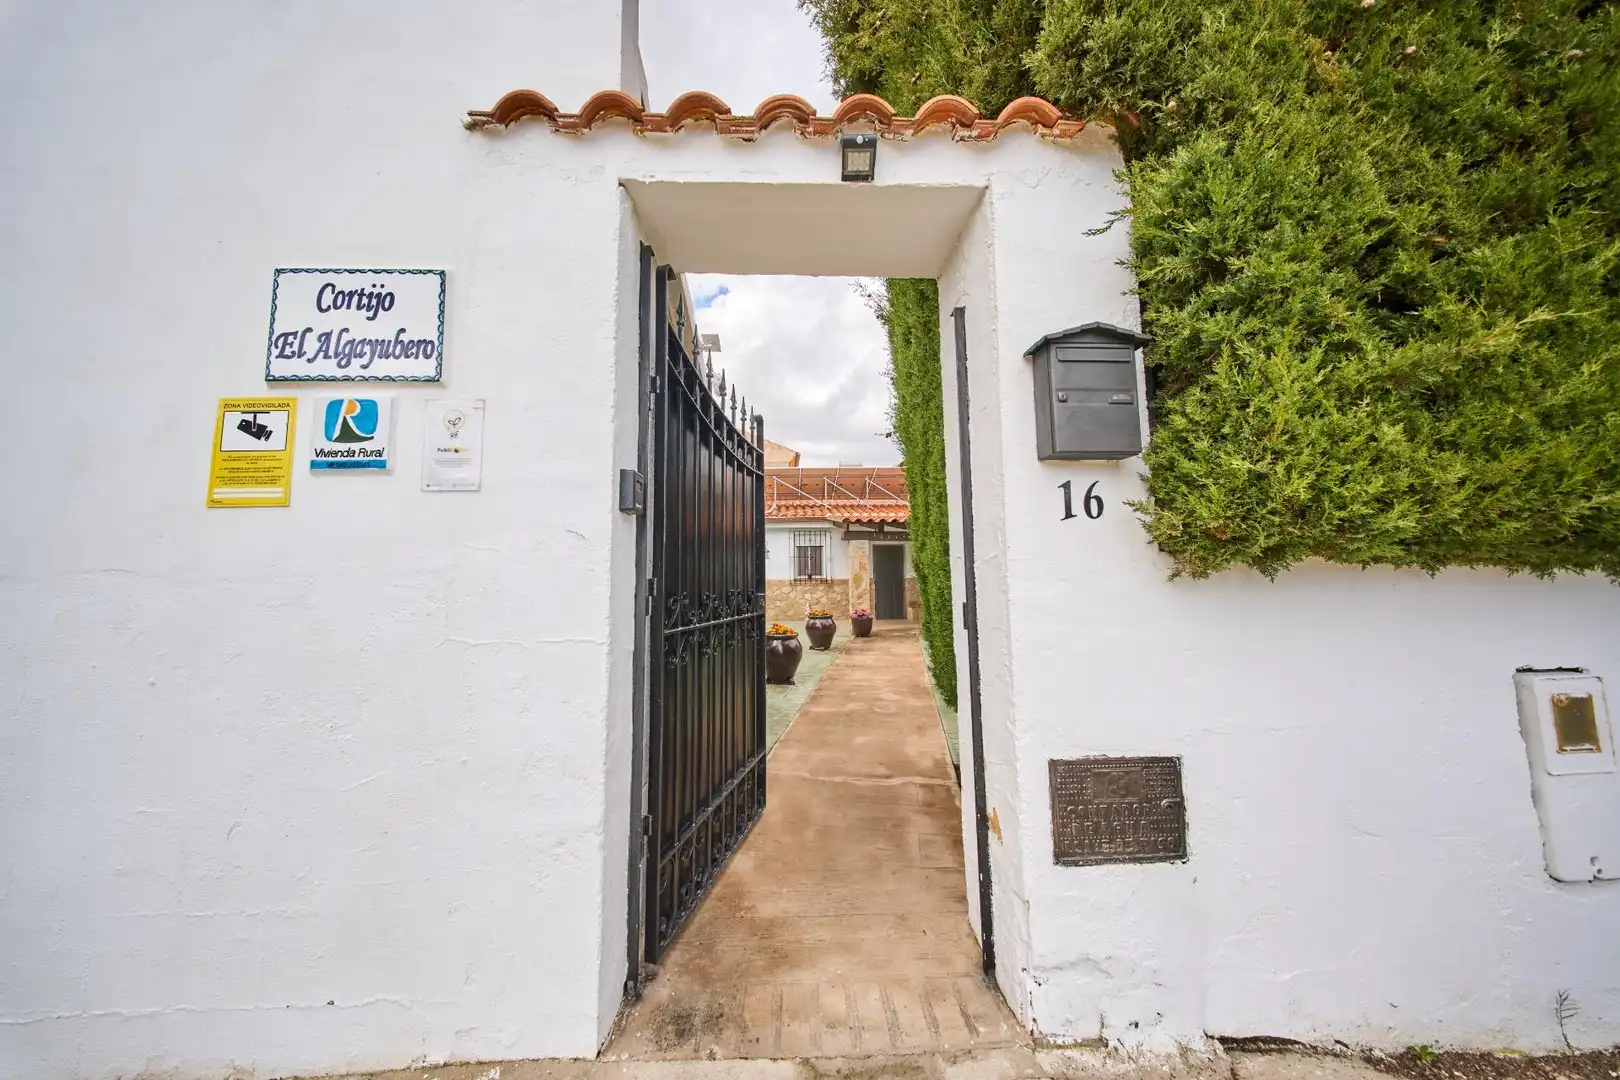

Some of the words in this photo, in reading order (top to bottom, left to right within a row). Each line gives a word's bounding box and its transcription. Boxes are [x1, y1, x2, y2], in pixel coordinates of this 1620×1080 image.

[316, 282, 396, 321] Cortijo
[274, 327, 314, 359] El
[306, 327, 436, 369] Algayubero
[314, 447, 356, 458] Vivienda
[358, 447, 385, 458] Rural
[1057, 479, 1104, 521] 16
